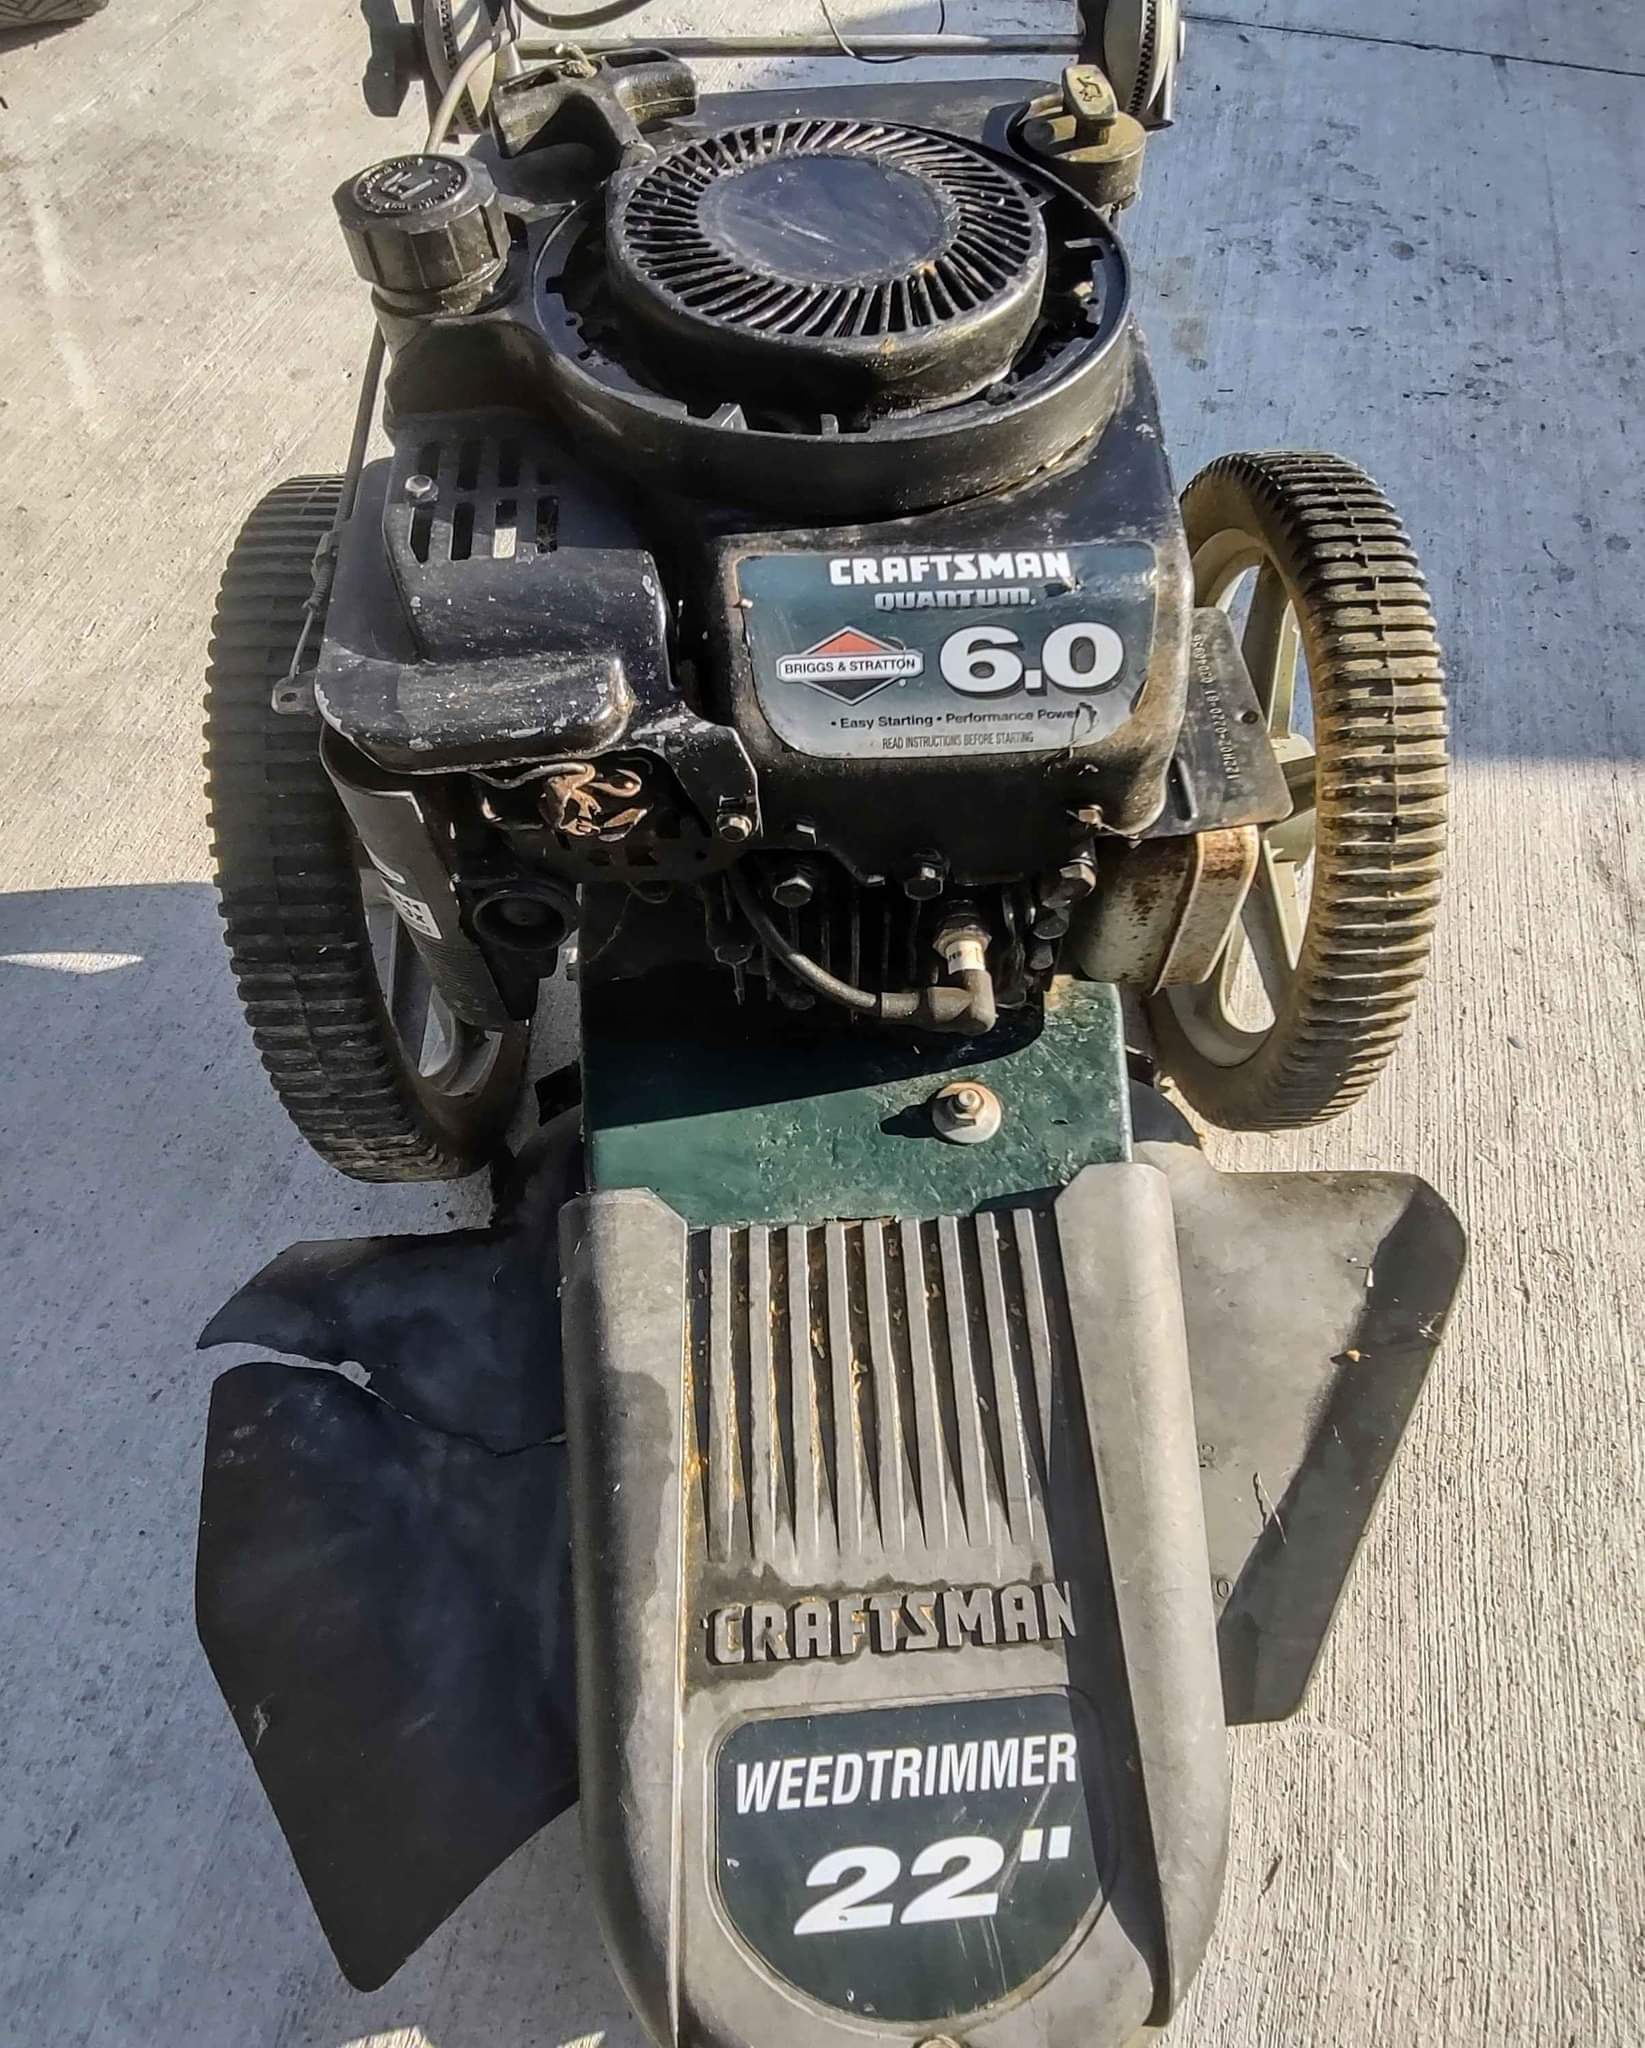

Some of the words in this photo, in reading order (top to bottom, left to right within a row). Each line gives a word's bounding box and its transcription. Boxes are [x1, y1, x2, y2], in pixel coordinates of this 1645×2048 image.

[829, 551, 1072, 586] CRAFTSMAN
[784, 661, 834, 676] BRIGGS
[837, 660, 846, 673] &
[849, 657, 916, 673] STRATTON
[940, 621, 1125, 697] 6.0
[840, 717, 875, 730] Easy
[878, 715, 934, 729] Starting
[946, 710, 1034, 725] Performance
[882, 736, 904, 750] READ
[905, 734, 962, 749] INSTRUCTIONS
[963, 732, 995, 746] BEFORE
[996, 731, 1035, 745] STARTING
[707, 1581, 1078, 1665] CRAFTSMAN
[736, 1732, 1078, 1815] WEEDTRIMMER
[793, 1825, 1072, 1936] 22"
